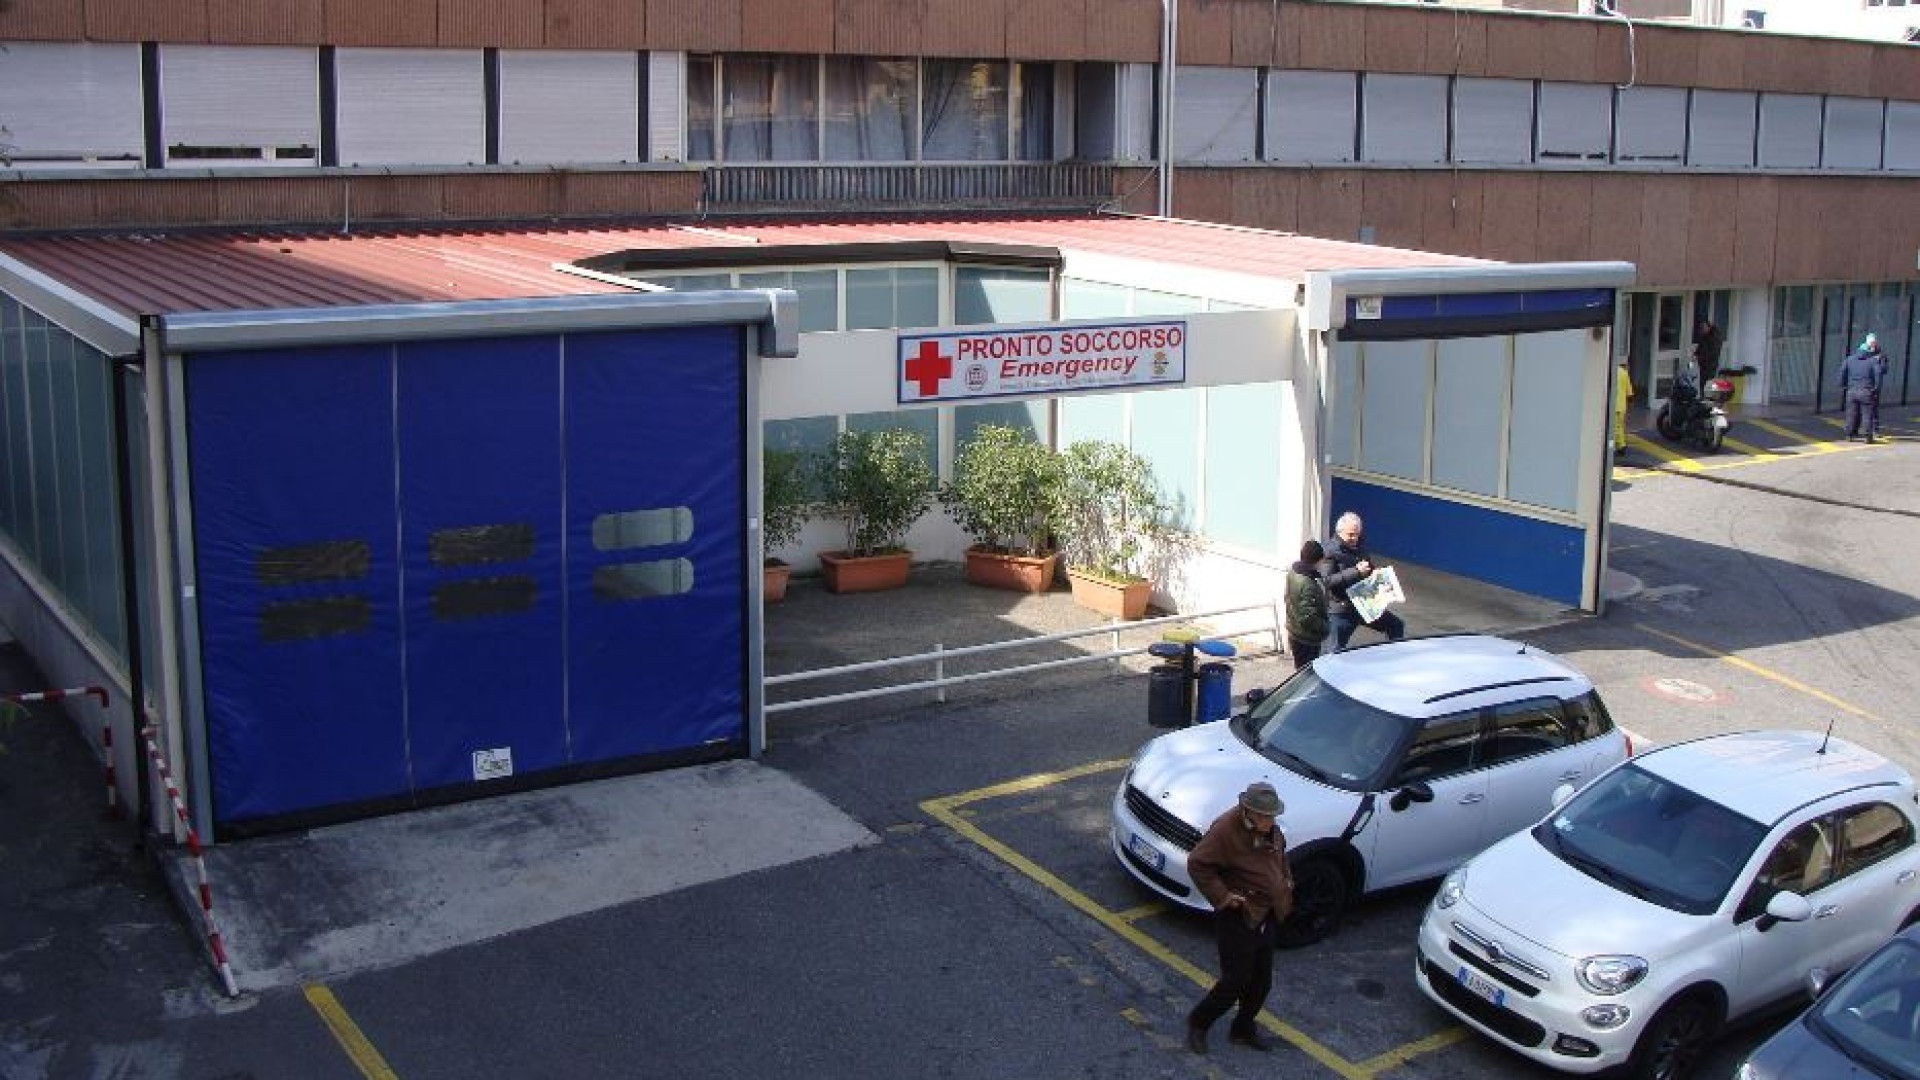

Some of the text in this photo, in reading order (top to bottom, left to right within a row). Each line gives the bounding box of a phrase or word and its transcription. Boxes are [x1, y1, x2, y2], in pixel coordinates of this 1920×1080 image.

[958, 327, 1182, 360] PRONTO SOCCORSO
[1000, 356, 1138, 379] Emergency
